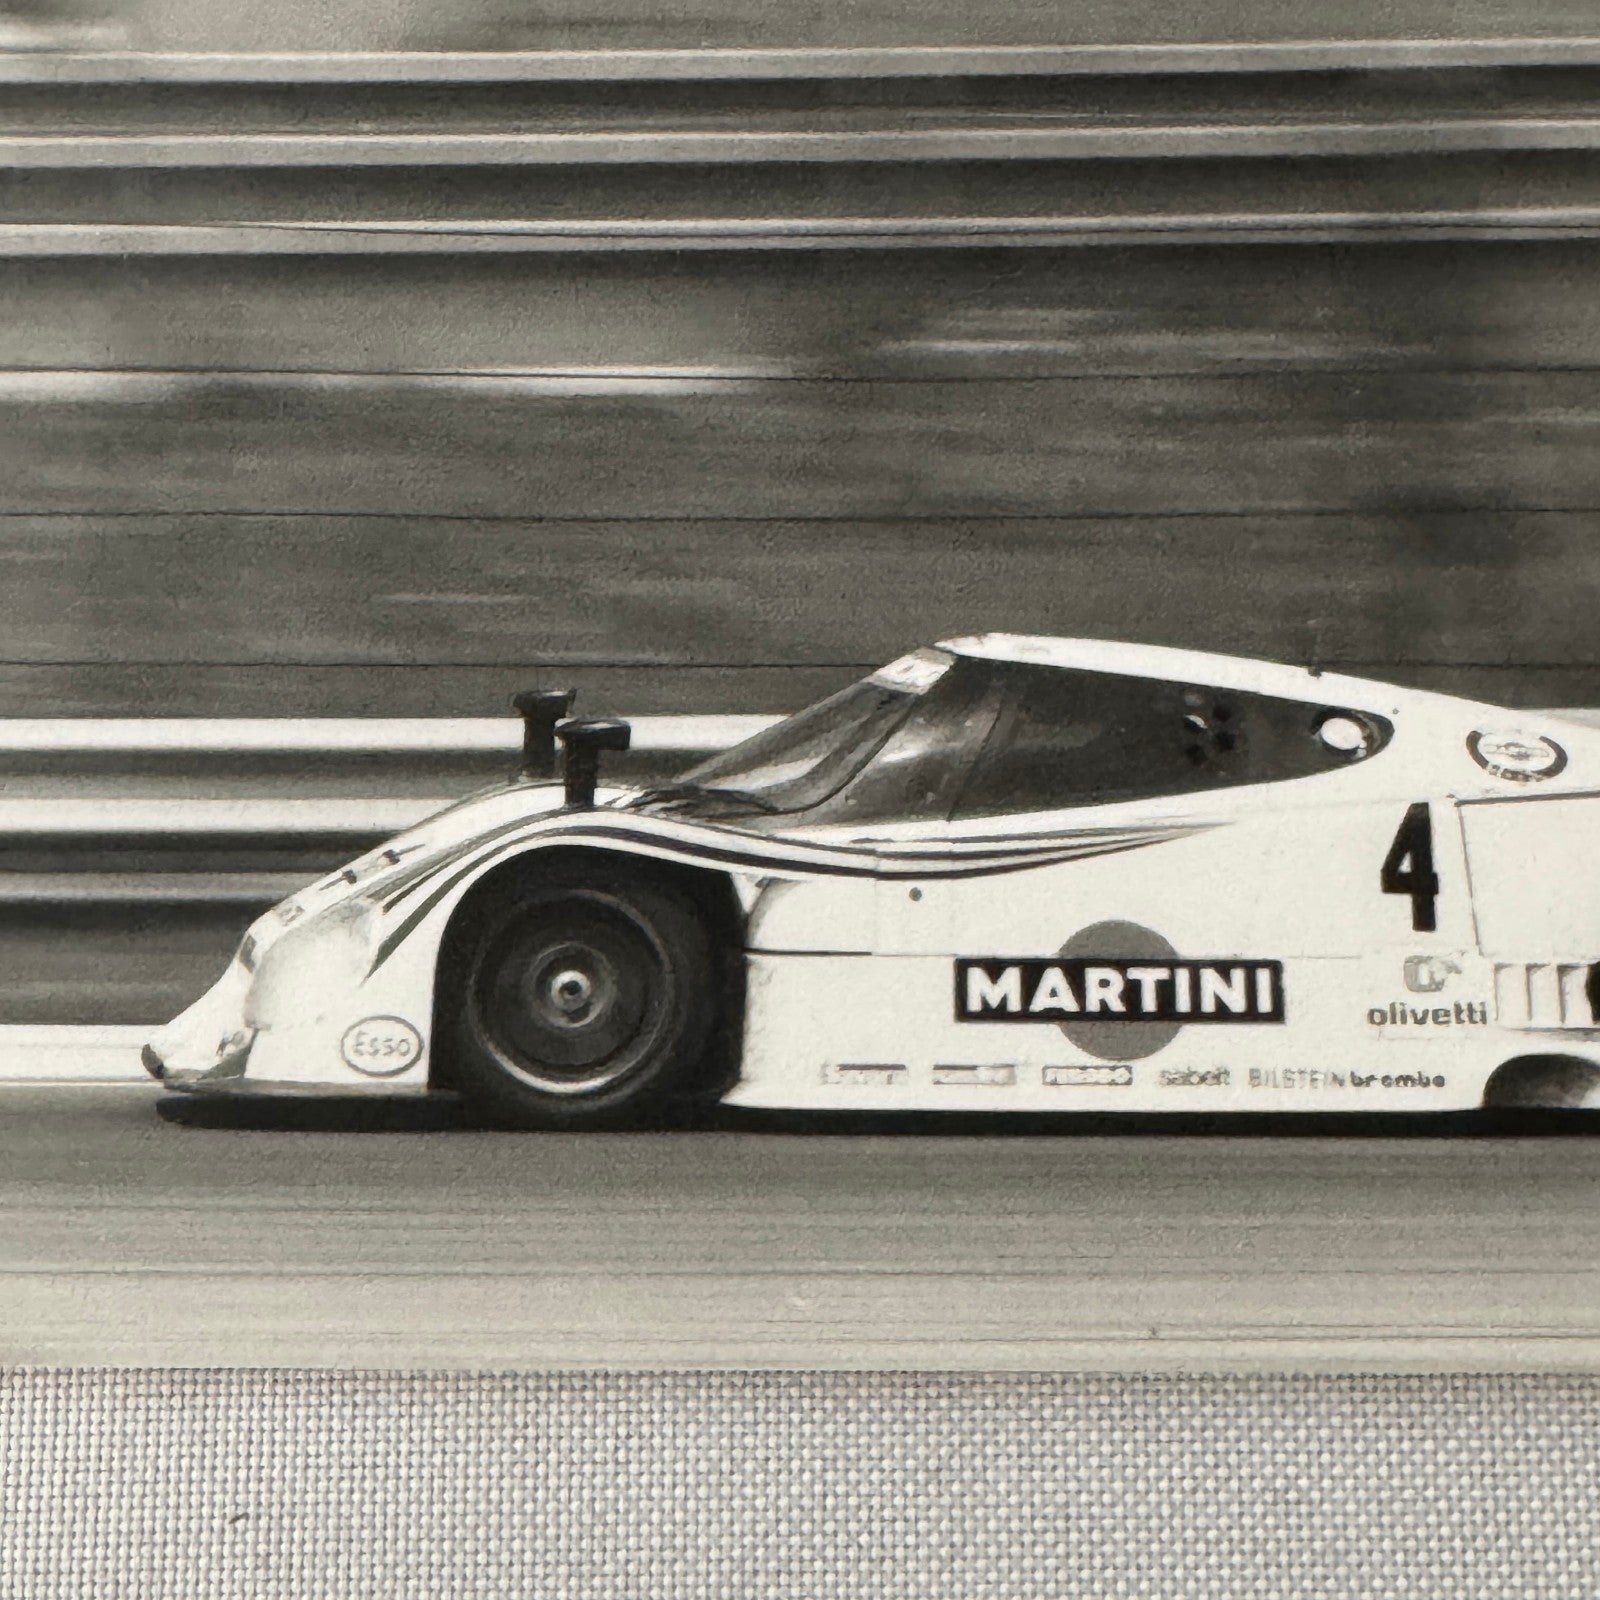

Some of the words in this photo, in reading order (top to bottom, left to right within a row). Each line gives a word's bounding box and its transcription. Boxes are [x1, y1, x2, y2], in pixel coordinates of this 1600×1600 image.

[1380, 801, 1439, 932] 4
[966, 966, 1274, 1013] MARTINI
[1367, 1001, 1488, 1026] olivetti
[1351, 1070, 1446, 1087] brembo
